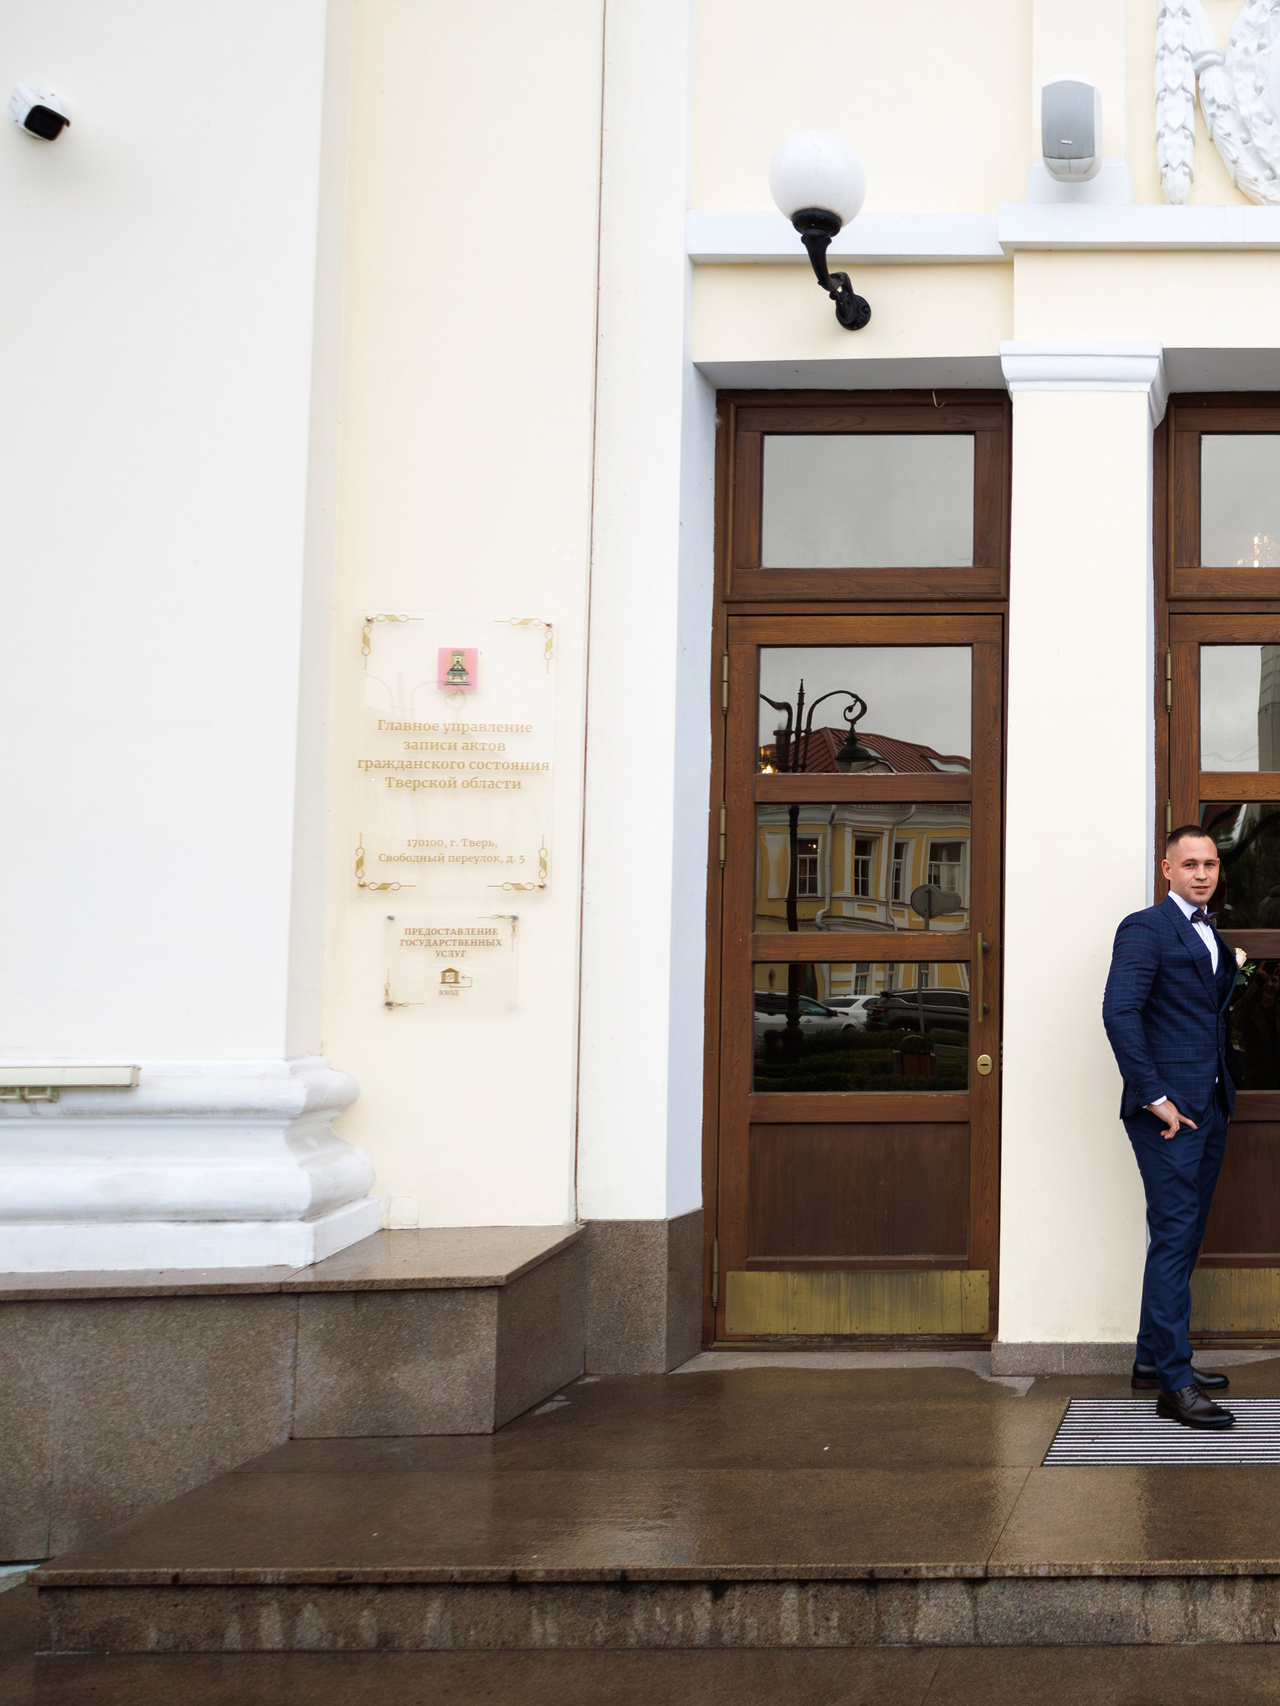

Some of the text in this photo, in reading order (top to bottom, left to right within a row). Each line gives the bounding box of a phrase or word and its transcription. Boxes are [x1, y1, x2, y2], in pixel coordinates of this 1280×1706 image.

[377, 719, 533, 735] Главное управление
[403, 740, 506, 752] записи актов
[357, 758, 549, 772] гражданского состояния
[385, 775, 522, 791] Тверской области
[406, 838, 498, 850] 170100, г. Тверь,
[378, 853, 525, 865] Свободный переулок, д. 5
[404, 927, 498, 936] ПРЕДОСТАВЛЕНИЕ
[400, 938, 502, 947] ГОСУДАРСТВЕННЫХ
[435, 949, 467, 958] УСЛУГ
